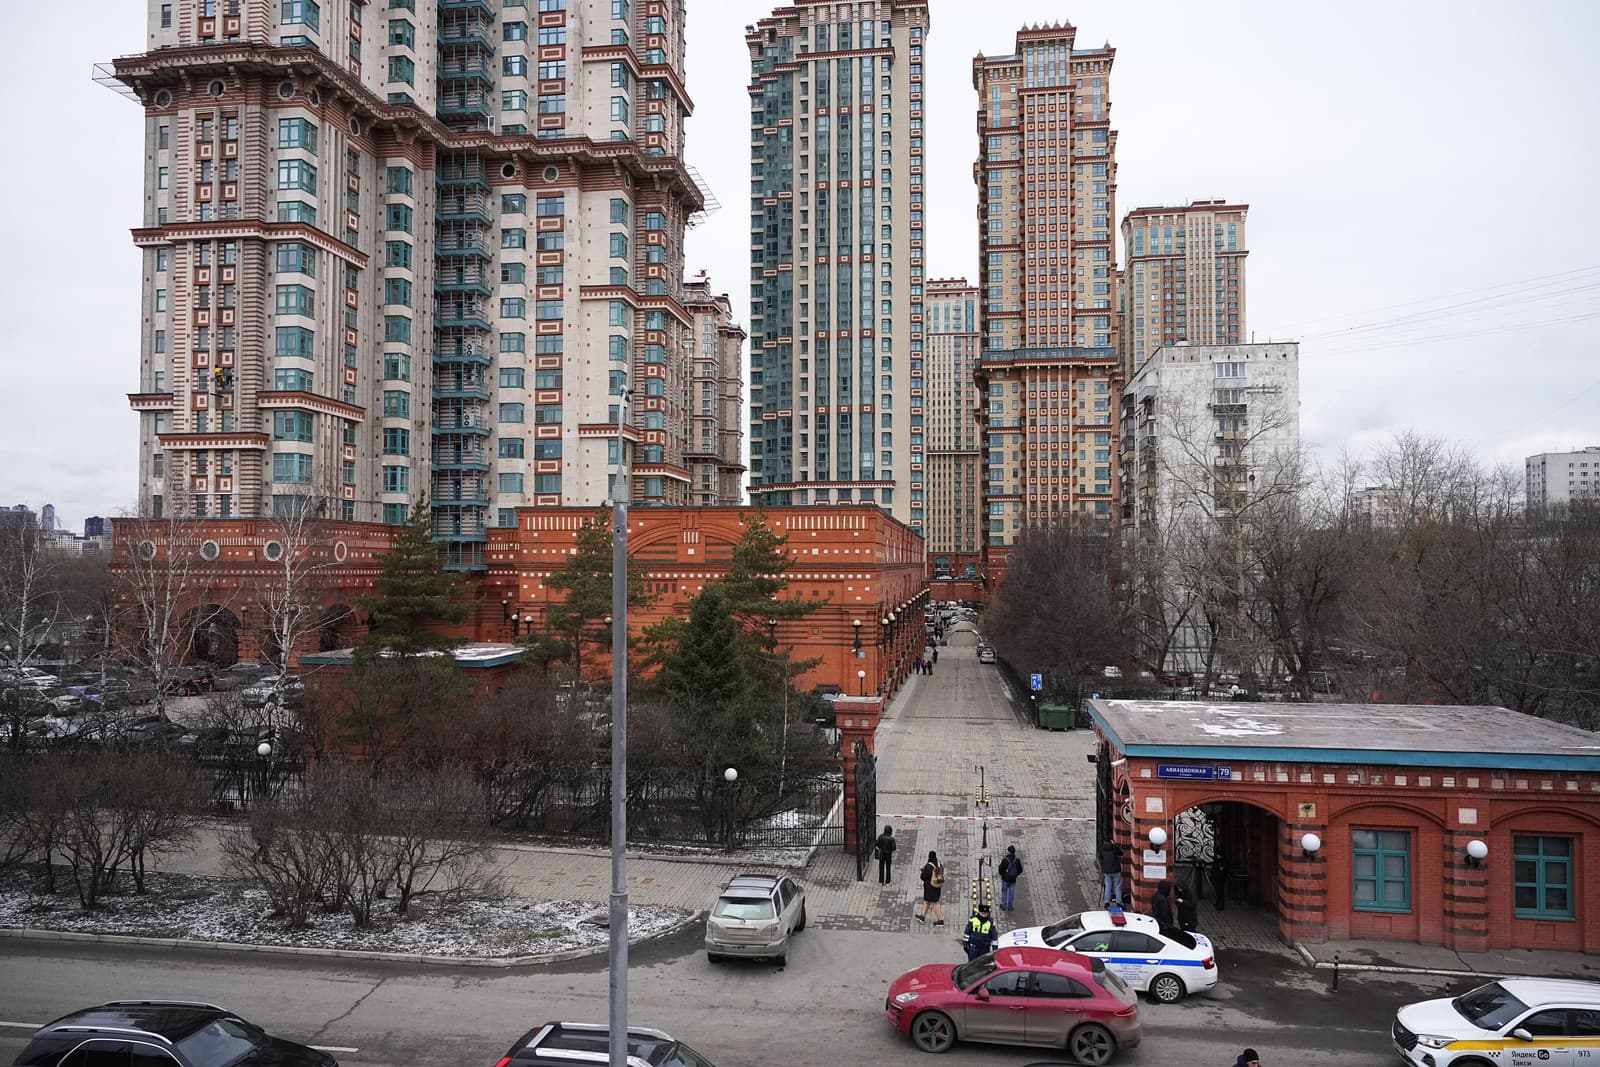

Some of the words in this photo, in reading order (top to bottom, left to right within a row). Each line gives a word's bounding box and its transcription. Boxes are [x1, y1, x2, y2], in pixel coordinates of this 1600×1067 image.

[1219, 768, 1230, 776] 79
[1511, 1050, 1536, 1058] Яндекс
[1578, 1050, 1591, 1058] 973
